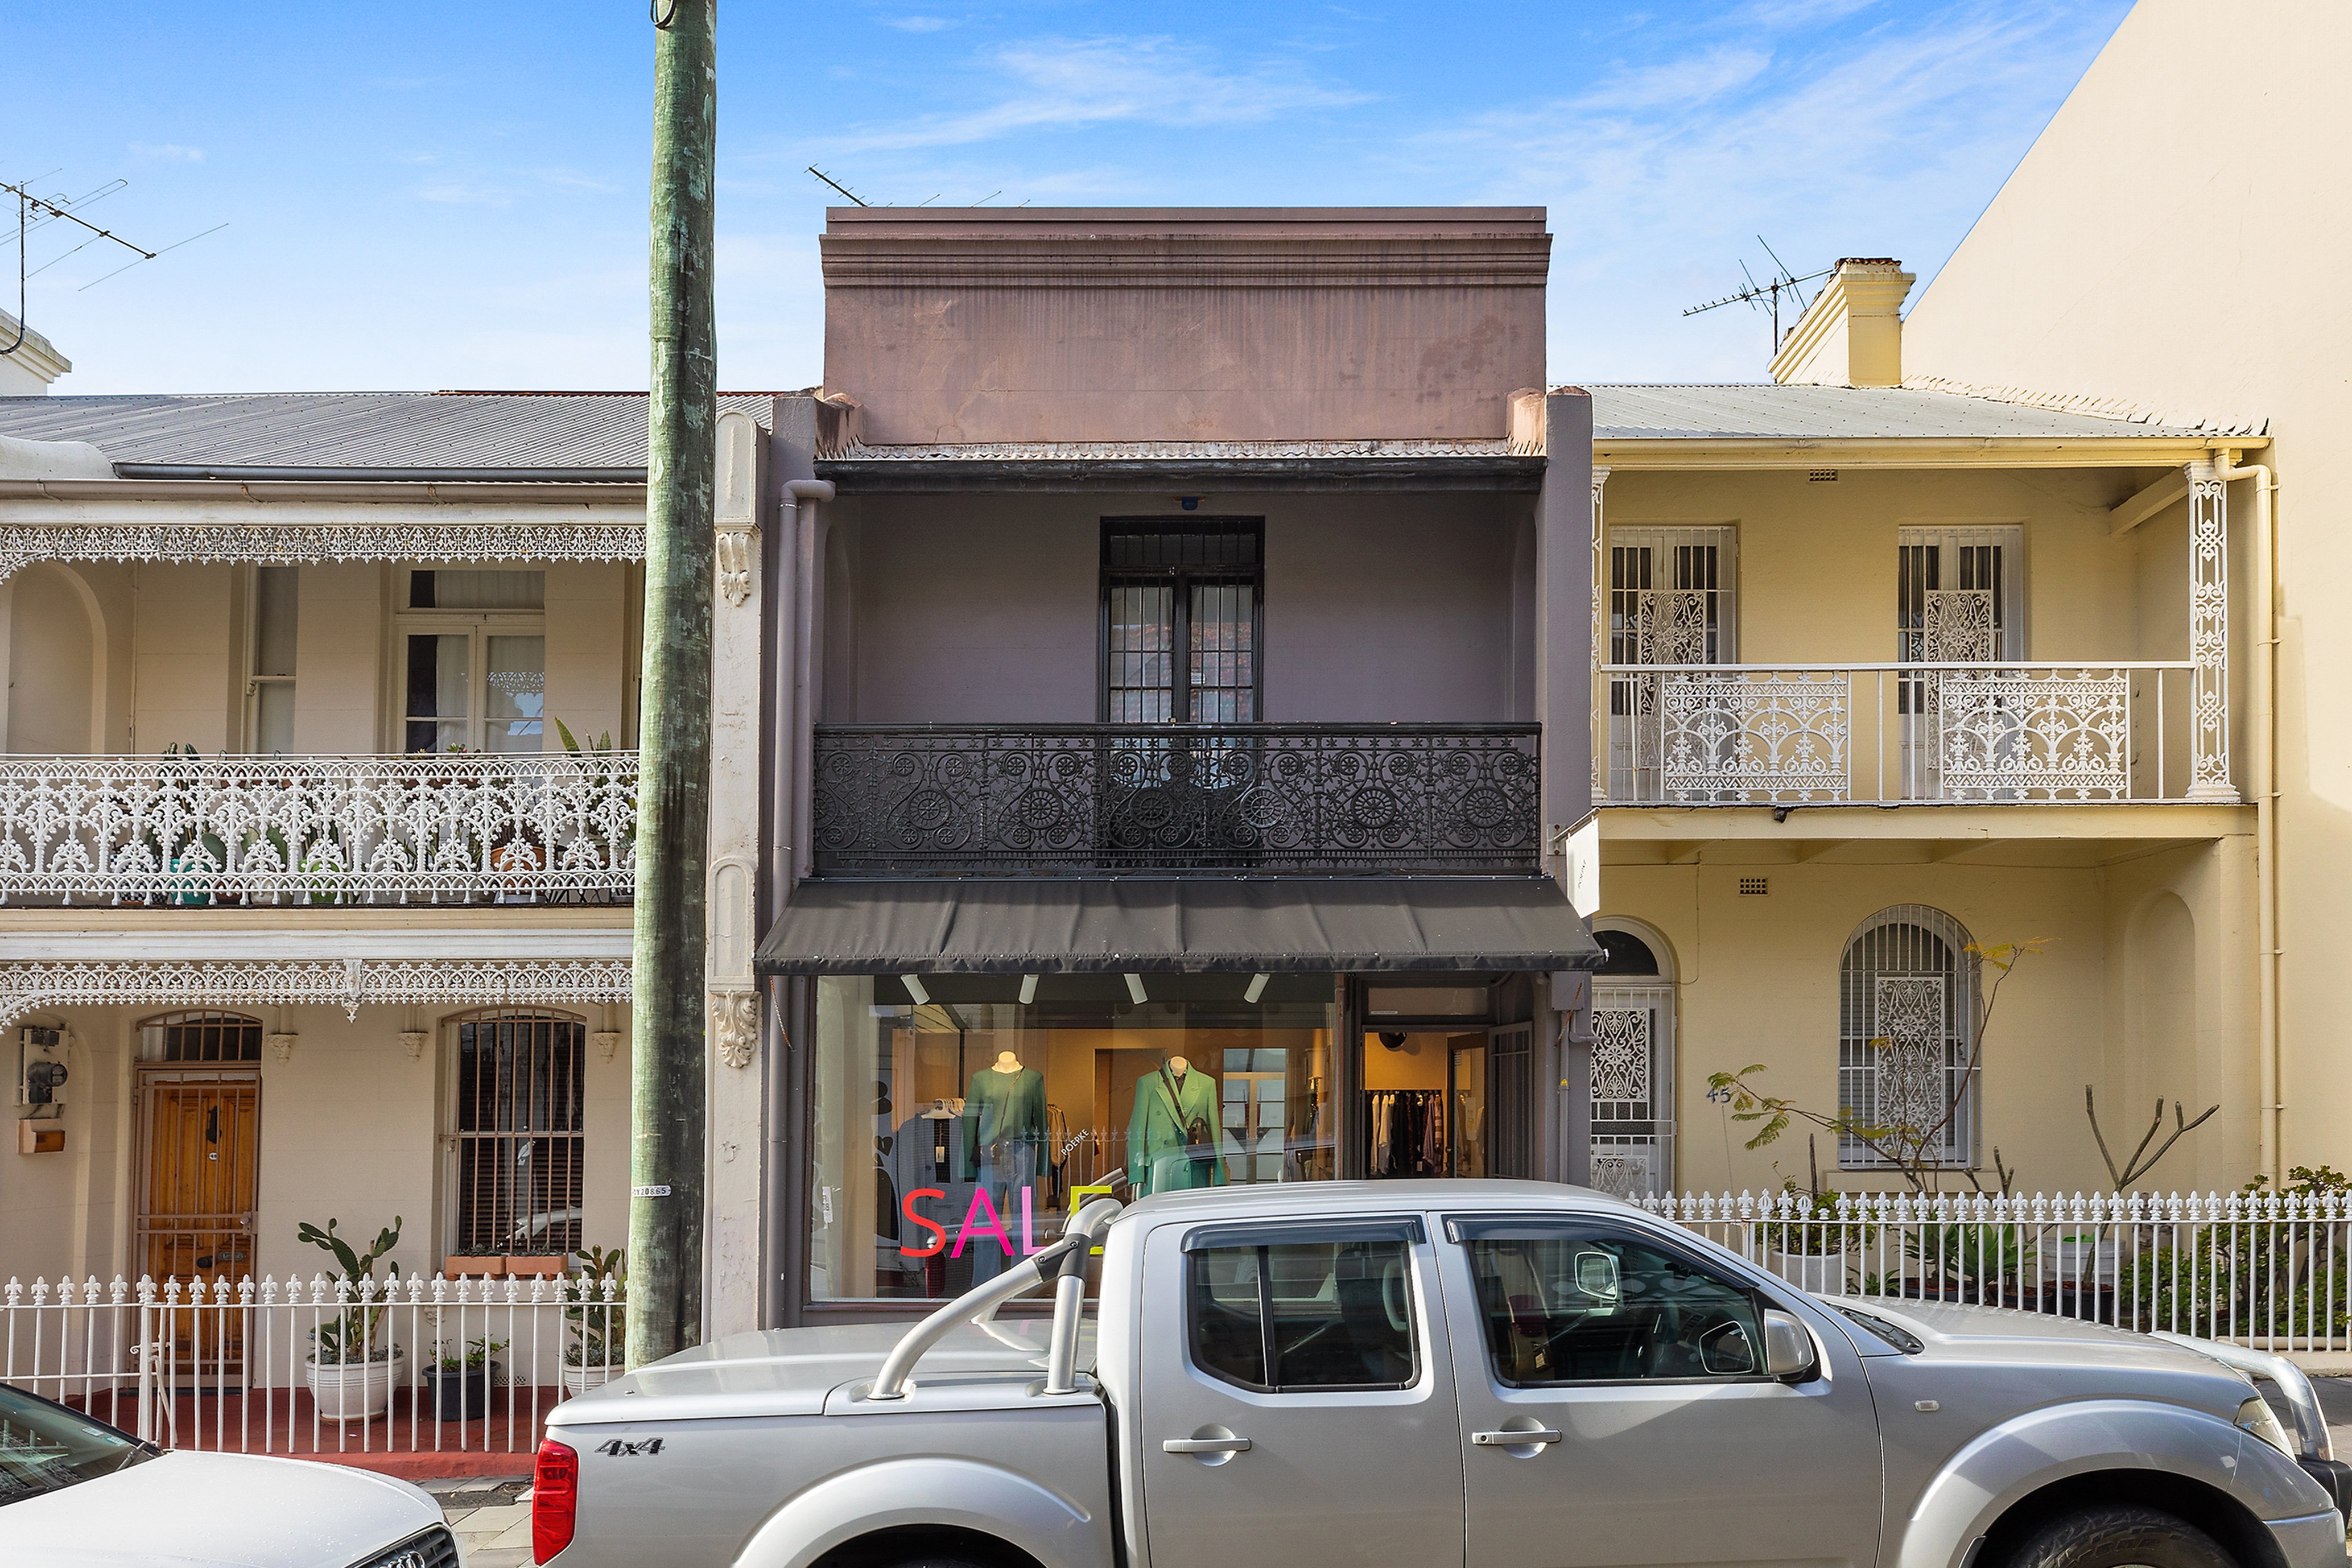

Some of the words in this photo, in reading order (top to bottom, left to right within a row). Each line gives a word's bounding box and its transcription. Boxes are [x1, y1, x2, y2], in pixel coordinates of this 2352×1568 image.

[1706, 1087, 1731, 1103] 45
[1061, 1128, 1090, 1156] POEPKE
[595, 1437, 665, 1457] 4x4
